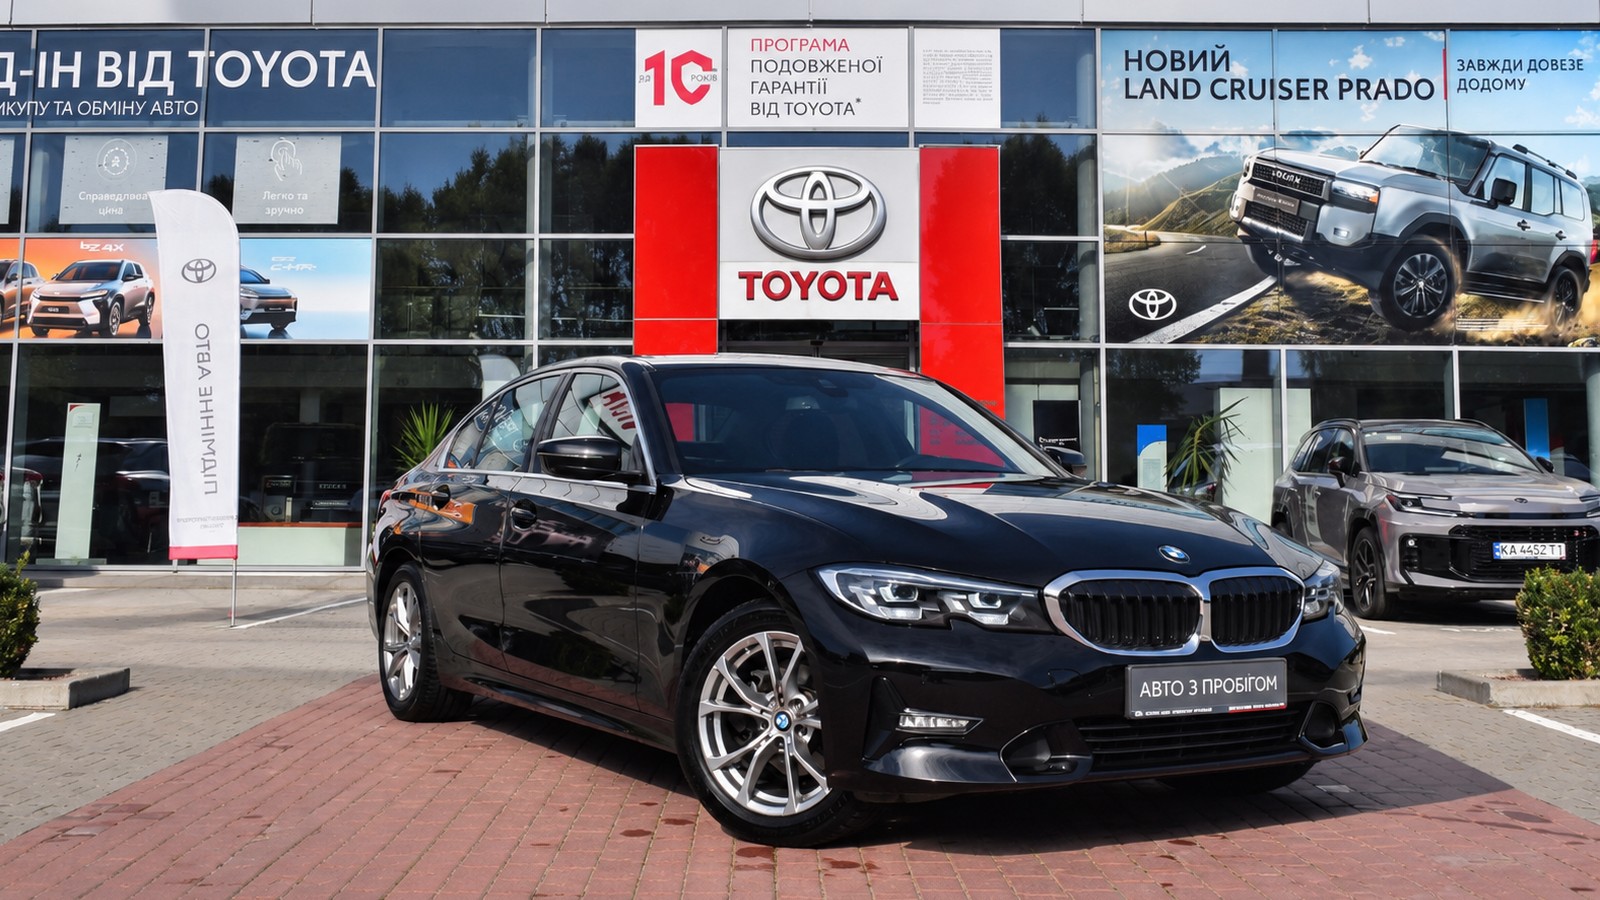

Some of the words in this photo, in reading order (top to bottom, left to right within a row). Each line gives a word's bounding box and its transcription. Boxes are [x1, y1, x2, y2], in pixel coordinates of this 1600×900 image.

[751, 38, 850, 52] ПРОГРАМА
[751, 56, 883, 75] ПОДОВЖЕНОЇ
[1124, 44, 1231, 72] НОВИЙ
[1456, 58, 1523, 74] ЗАВЖДИ
[1527, 58, 1584, 74] ДОВЕЗЕ
[97, 51, 174, 96] ВІД
[188, 50, 376, 88] TOYOTA
[751, 77, 828, 95] ГАРАНТІЇ
[1124, 78, 1202, 100] LAND
[1209, 78, 1329, 101] CRUISER
[1338, 78, 1435, 101] PRADO
[1456, 77, 1526, 94] ДОДОМУ
[53, 101, 73, 116] ТА
[77, 101, 147, 116] ОБМІНУ
[149, 101, 198, 116] АВТО
[751, 102, 780, 117] ВІД
[262, 190, 295, 200] Легко
[264, 206, 304, 216] зручно
[738, 270, 899, 301] TOYOTA
[1501, 544, 1517, 555] KA
[1520, 544, 1547, 555] 4452
[1139, 679, 1184, 698] АВТО
